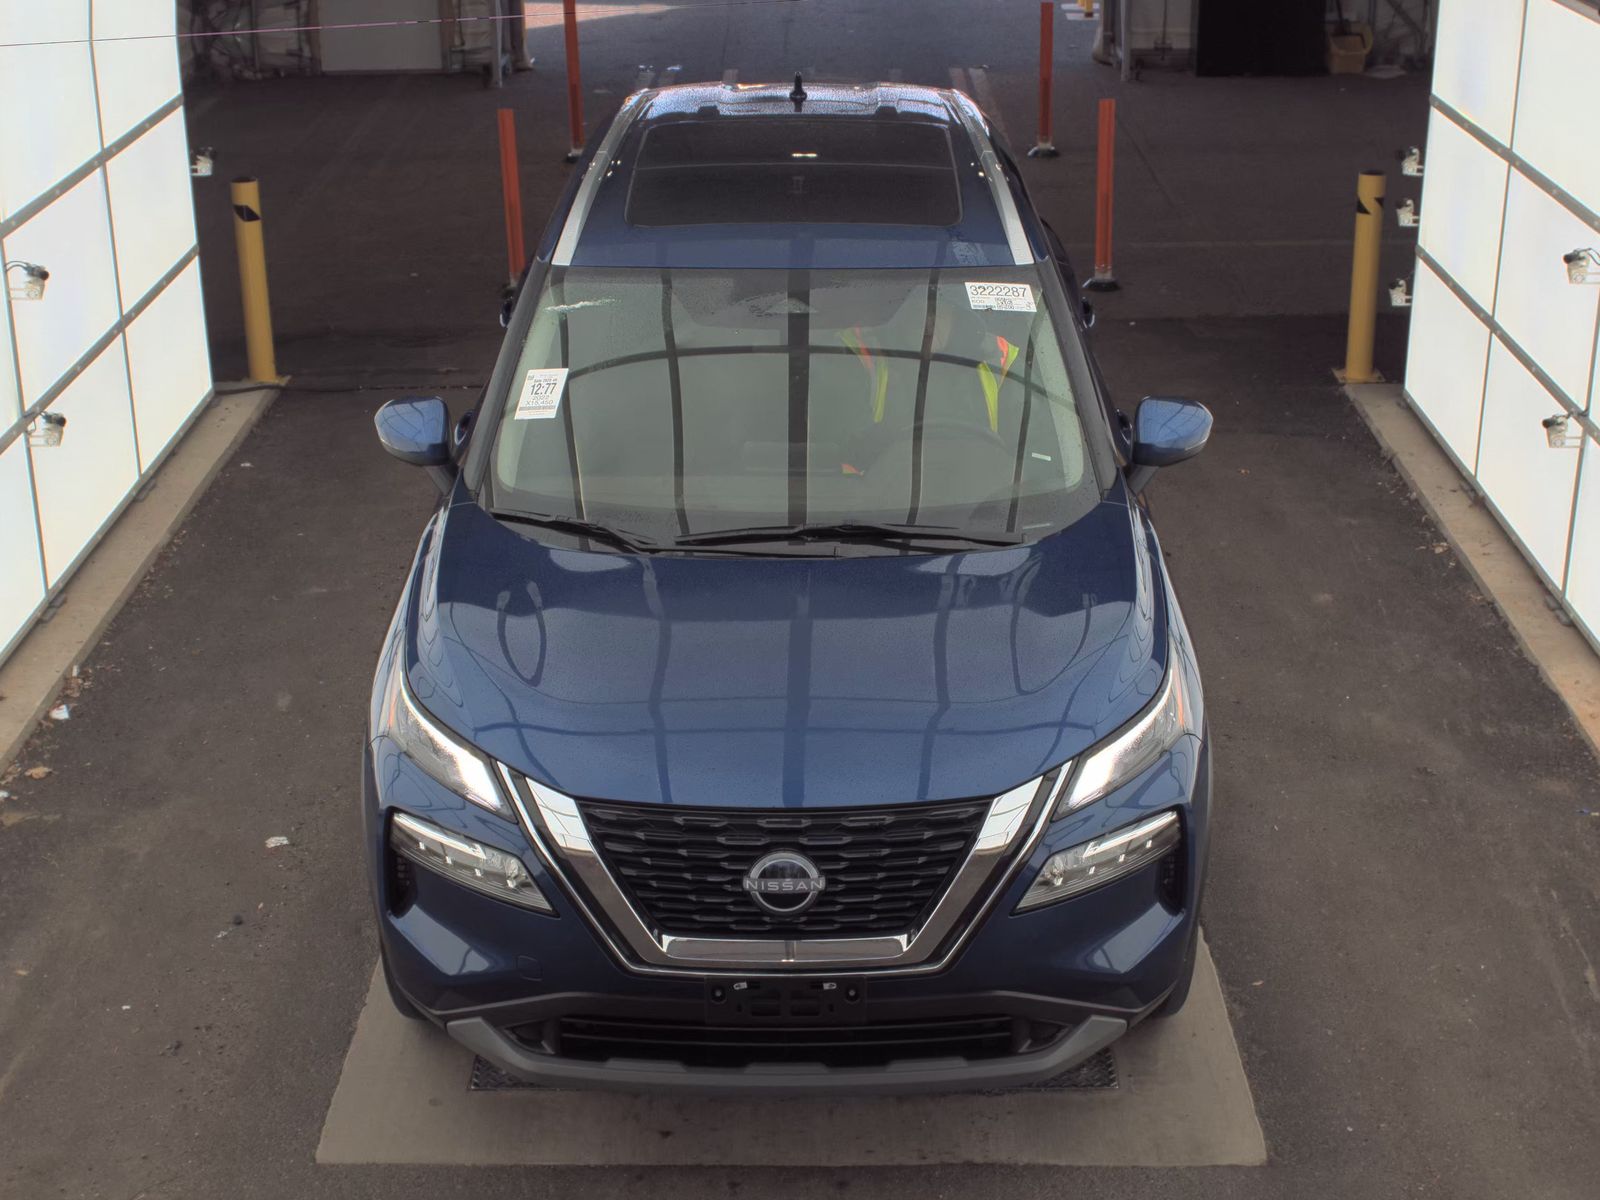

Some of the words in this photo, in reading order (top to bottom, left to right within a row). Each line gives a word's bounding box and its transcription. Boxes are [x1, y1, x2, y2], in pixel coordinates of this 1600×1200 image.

[970, 285, 1026, 297] 3222287
[530, 383, 557, 395] 12:77
[746, 880, 822, 891] NISSAN
